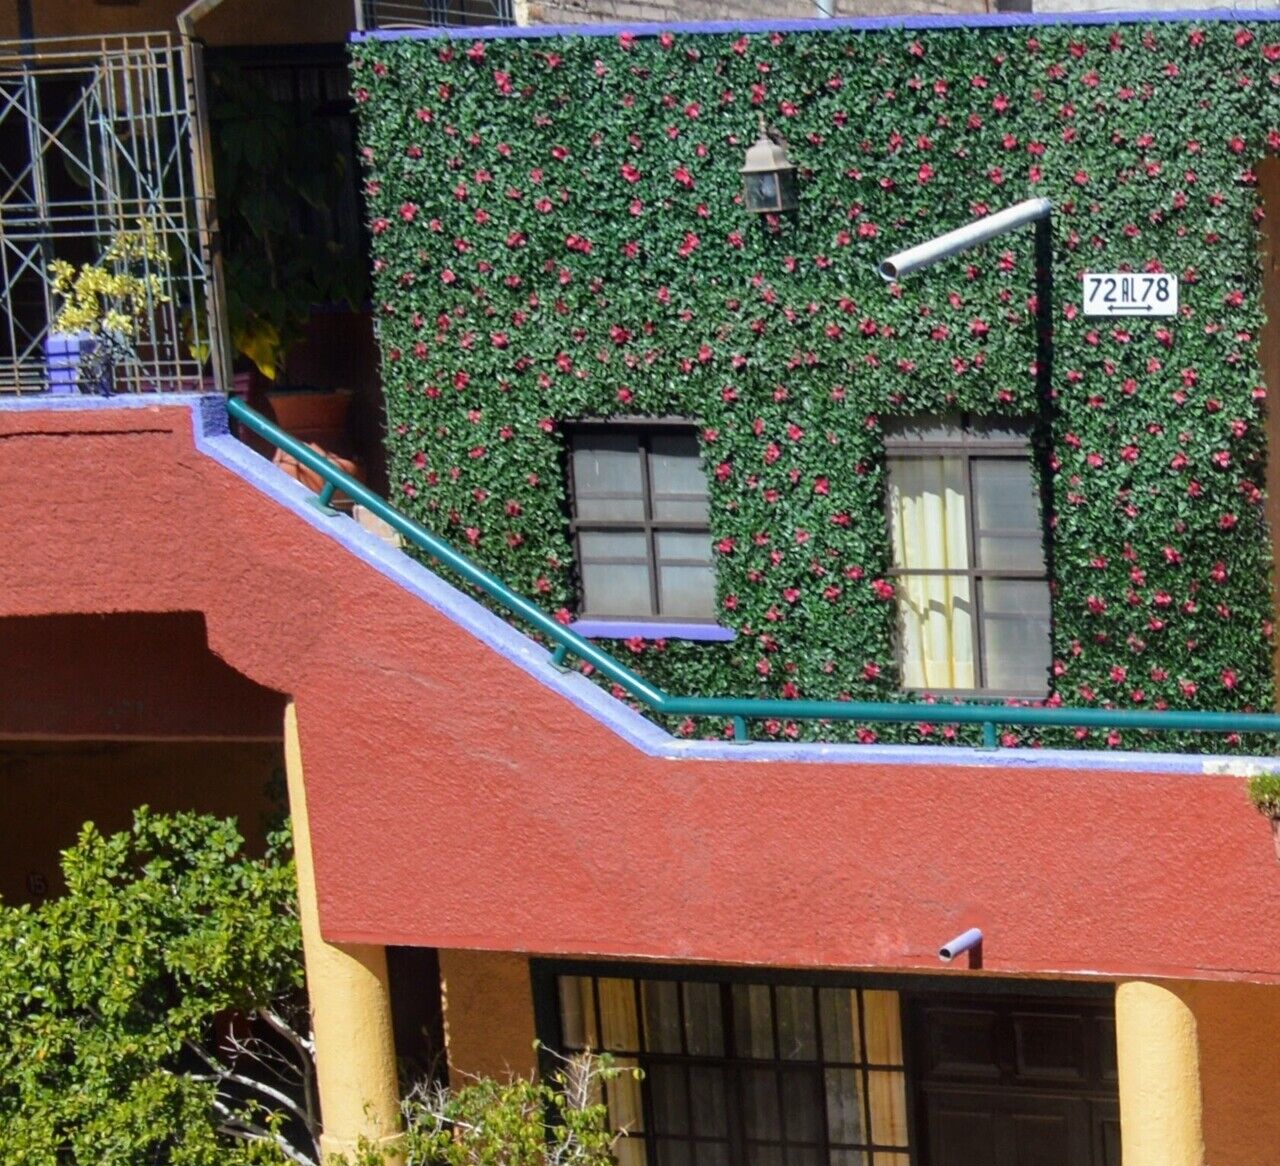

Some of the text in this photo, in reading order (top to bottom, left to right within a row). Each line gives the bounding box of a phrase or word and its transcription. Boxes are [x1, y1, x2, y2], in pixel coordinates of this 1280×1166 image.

[1089, 277, 1169, 302] 72 AL 78
